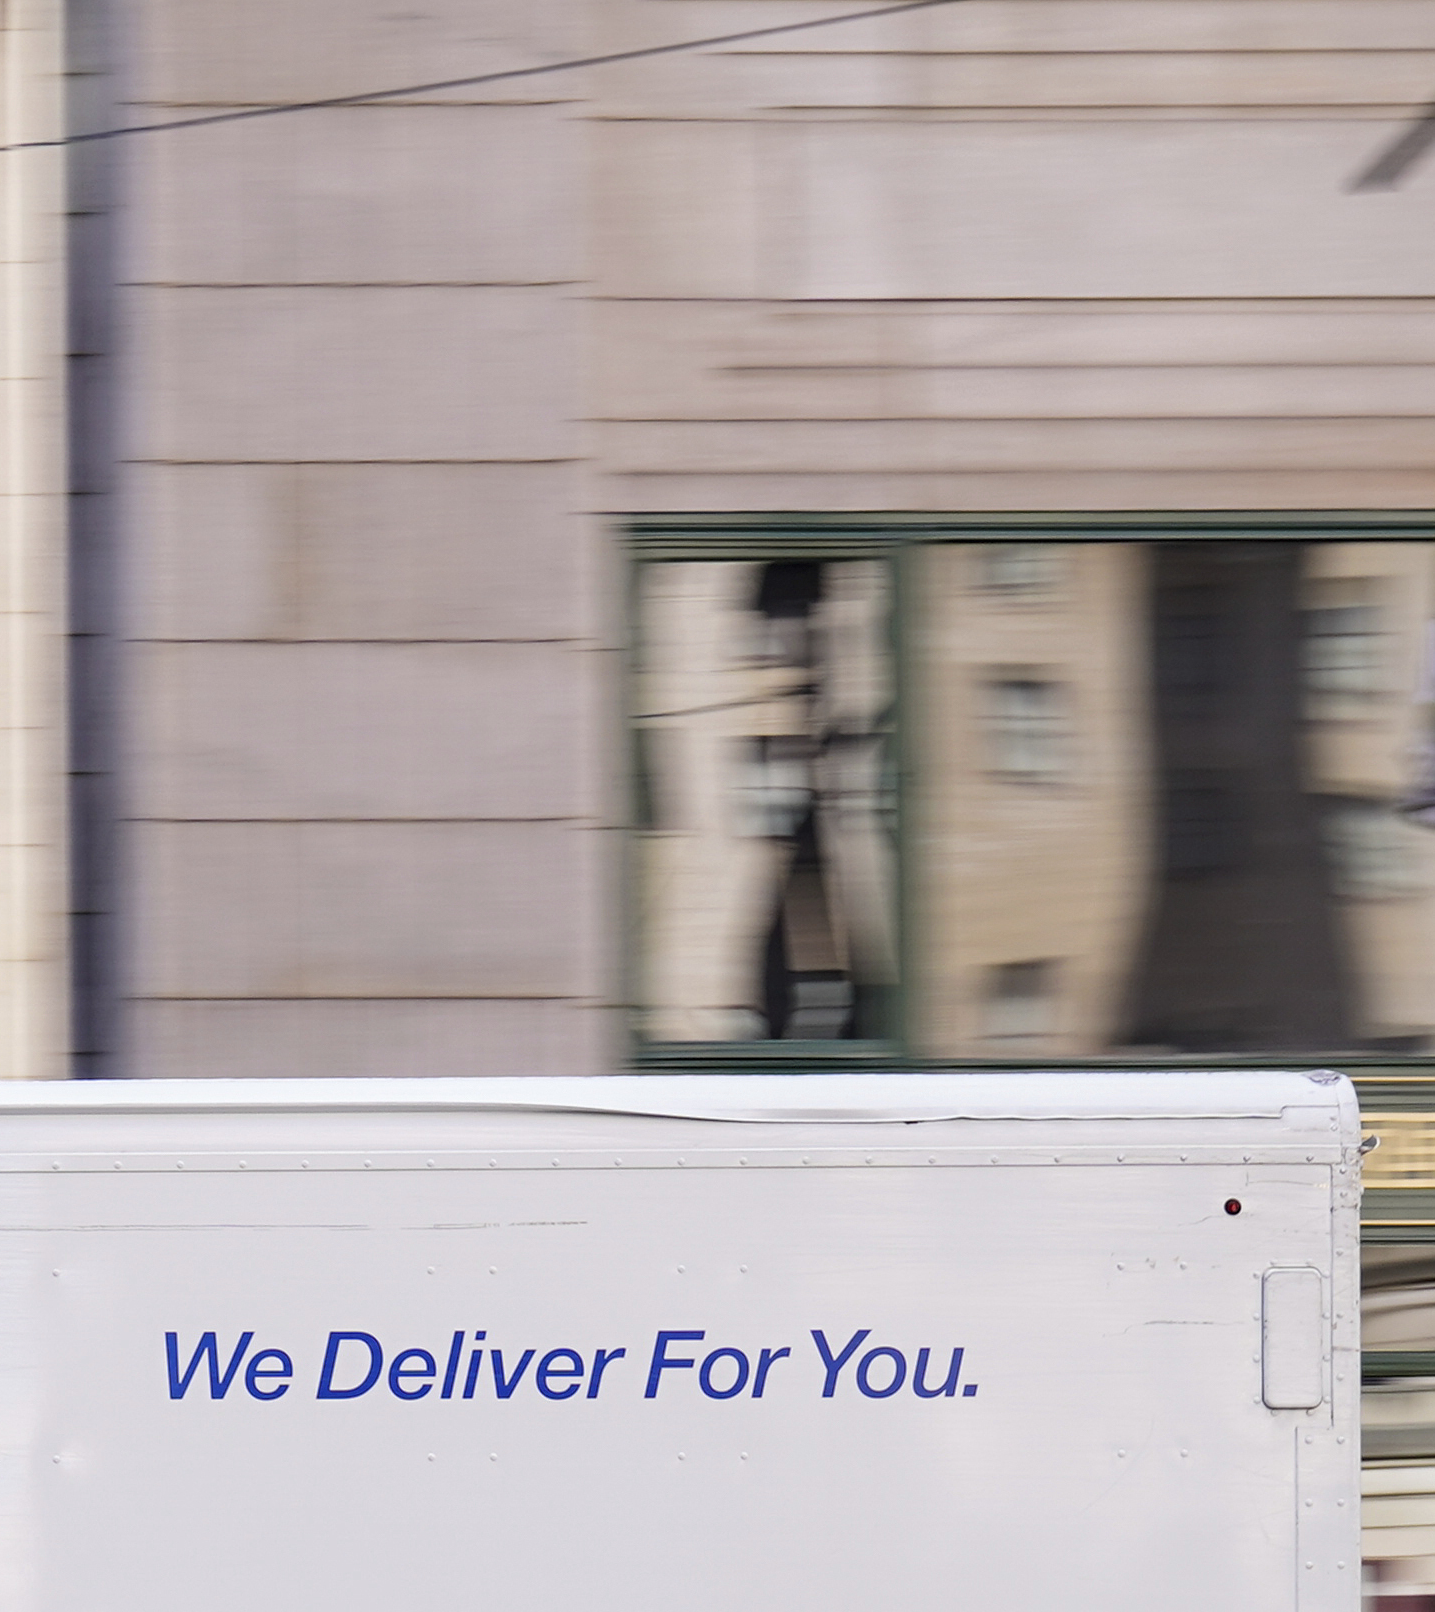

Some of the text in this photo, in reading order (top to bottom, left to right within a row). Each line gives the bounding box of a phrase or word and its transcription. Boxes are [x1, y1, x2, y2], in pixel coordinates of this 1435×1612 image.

[164, 1330, 977, 1402] We Deliver For You.
